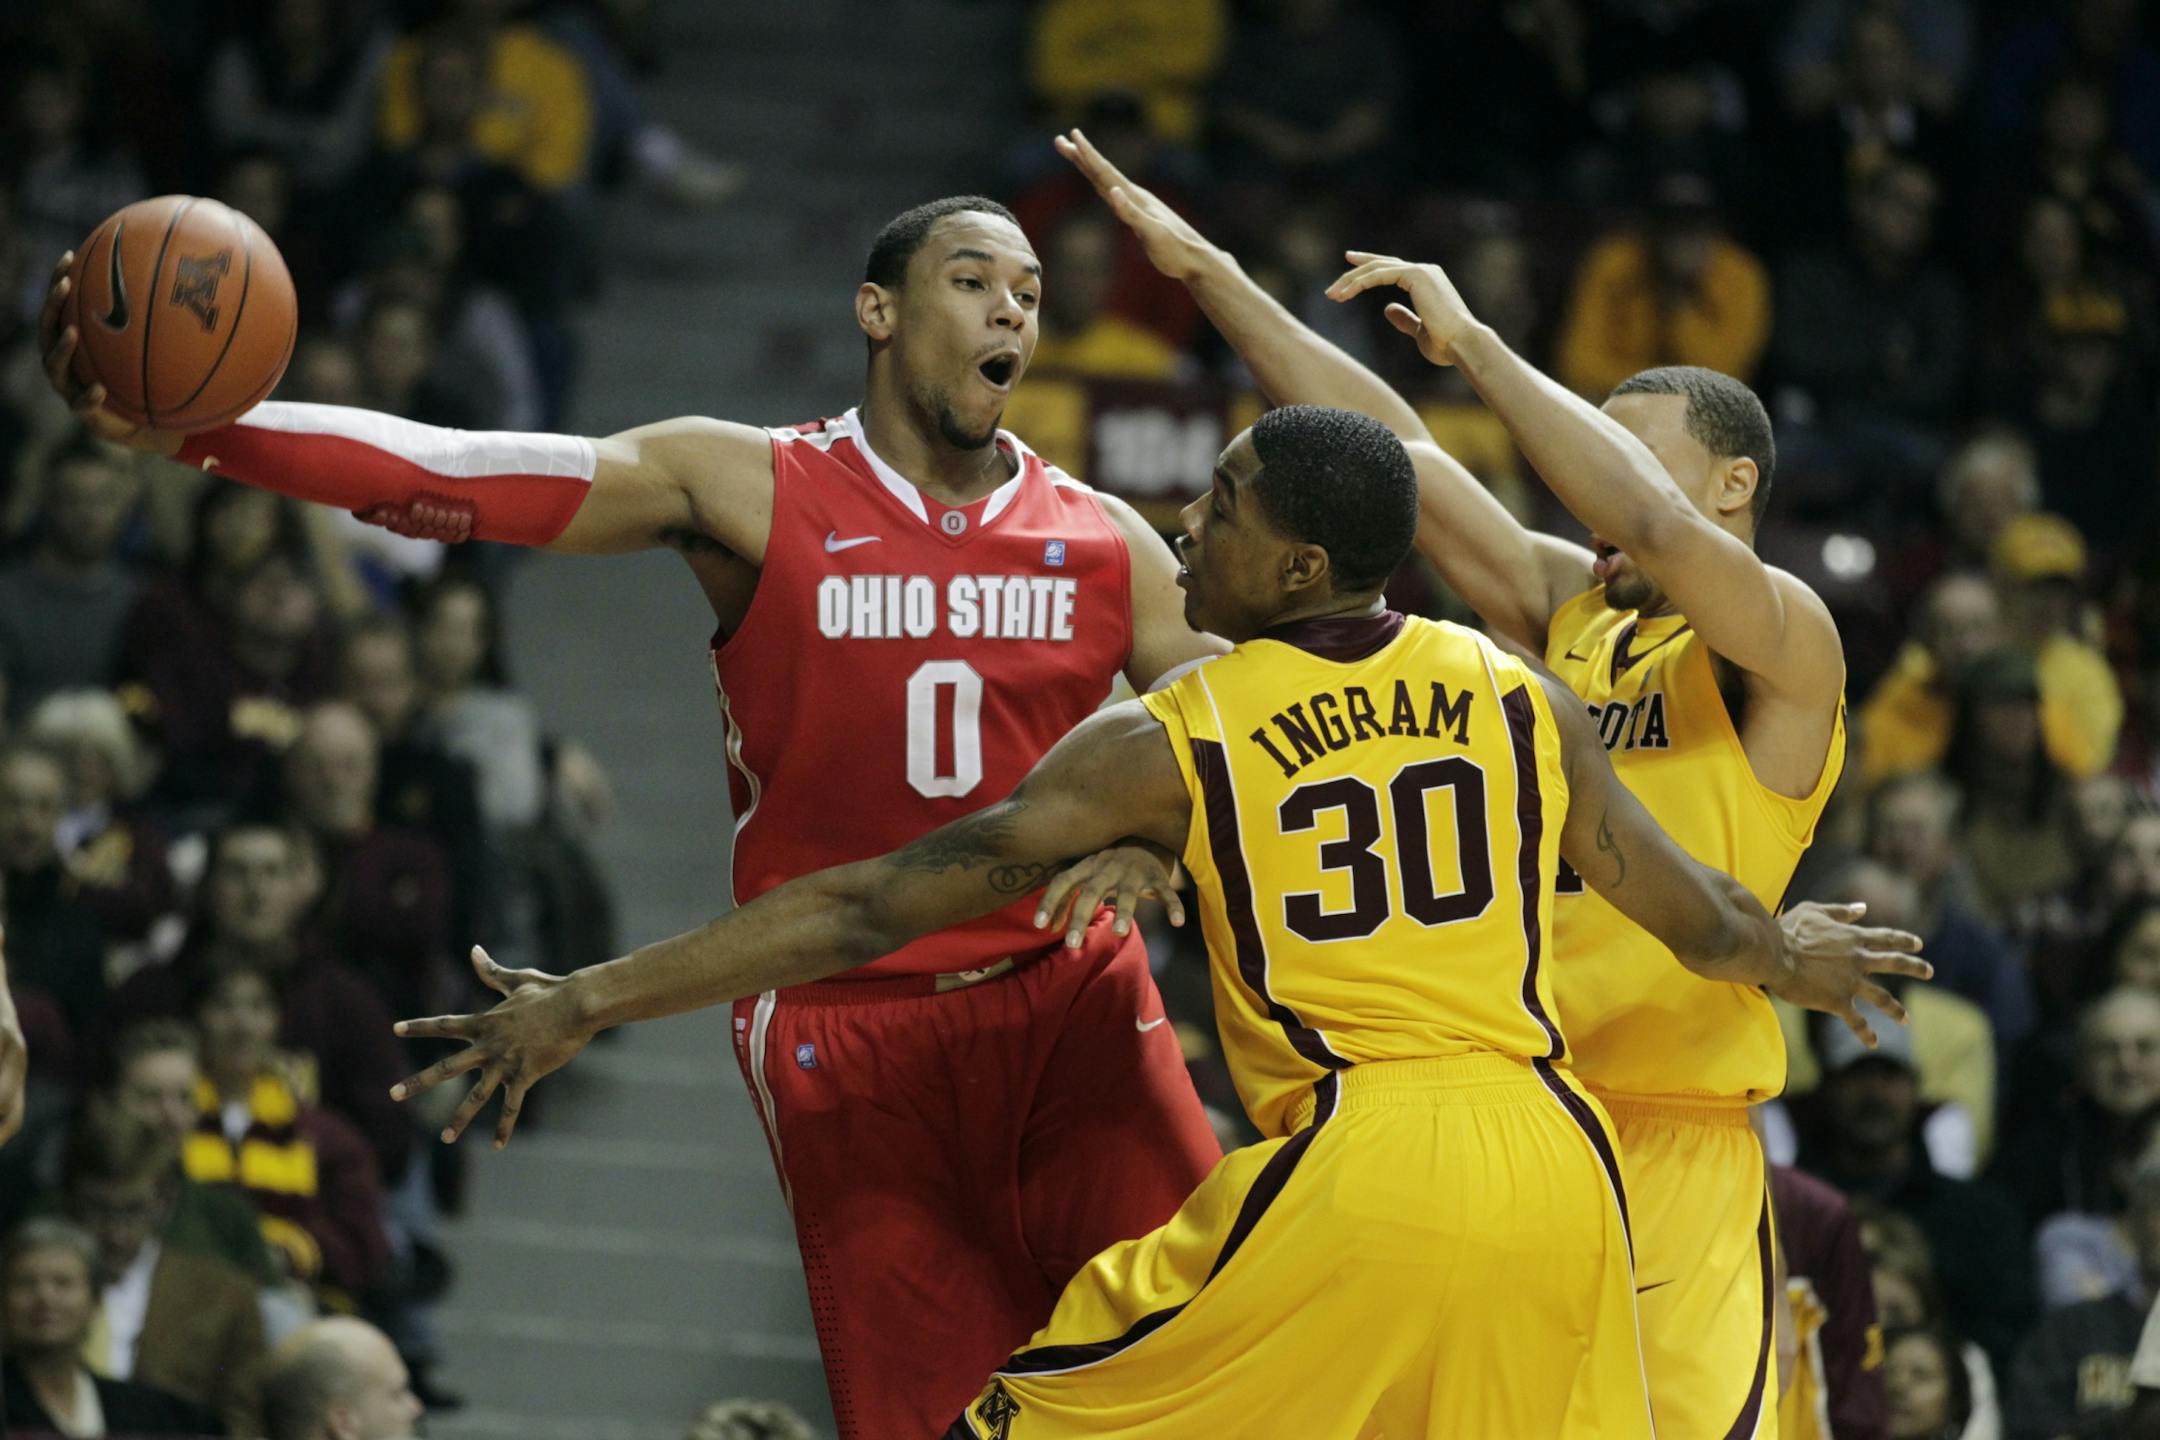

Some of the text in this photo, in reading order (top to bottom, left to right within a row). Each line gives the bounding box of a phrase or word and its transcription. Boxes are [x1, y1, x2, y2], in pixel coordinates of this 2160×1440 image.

[817, 575, 1077, 640] OHIO STATE
[906, 660, 984, 798] 0
[1249, 679, 1474, 779] INGRAM
[1587, 692, 1669, 750] OTA
[1277, 754, 1495, 943] 30
